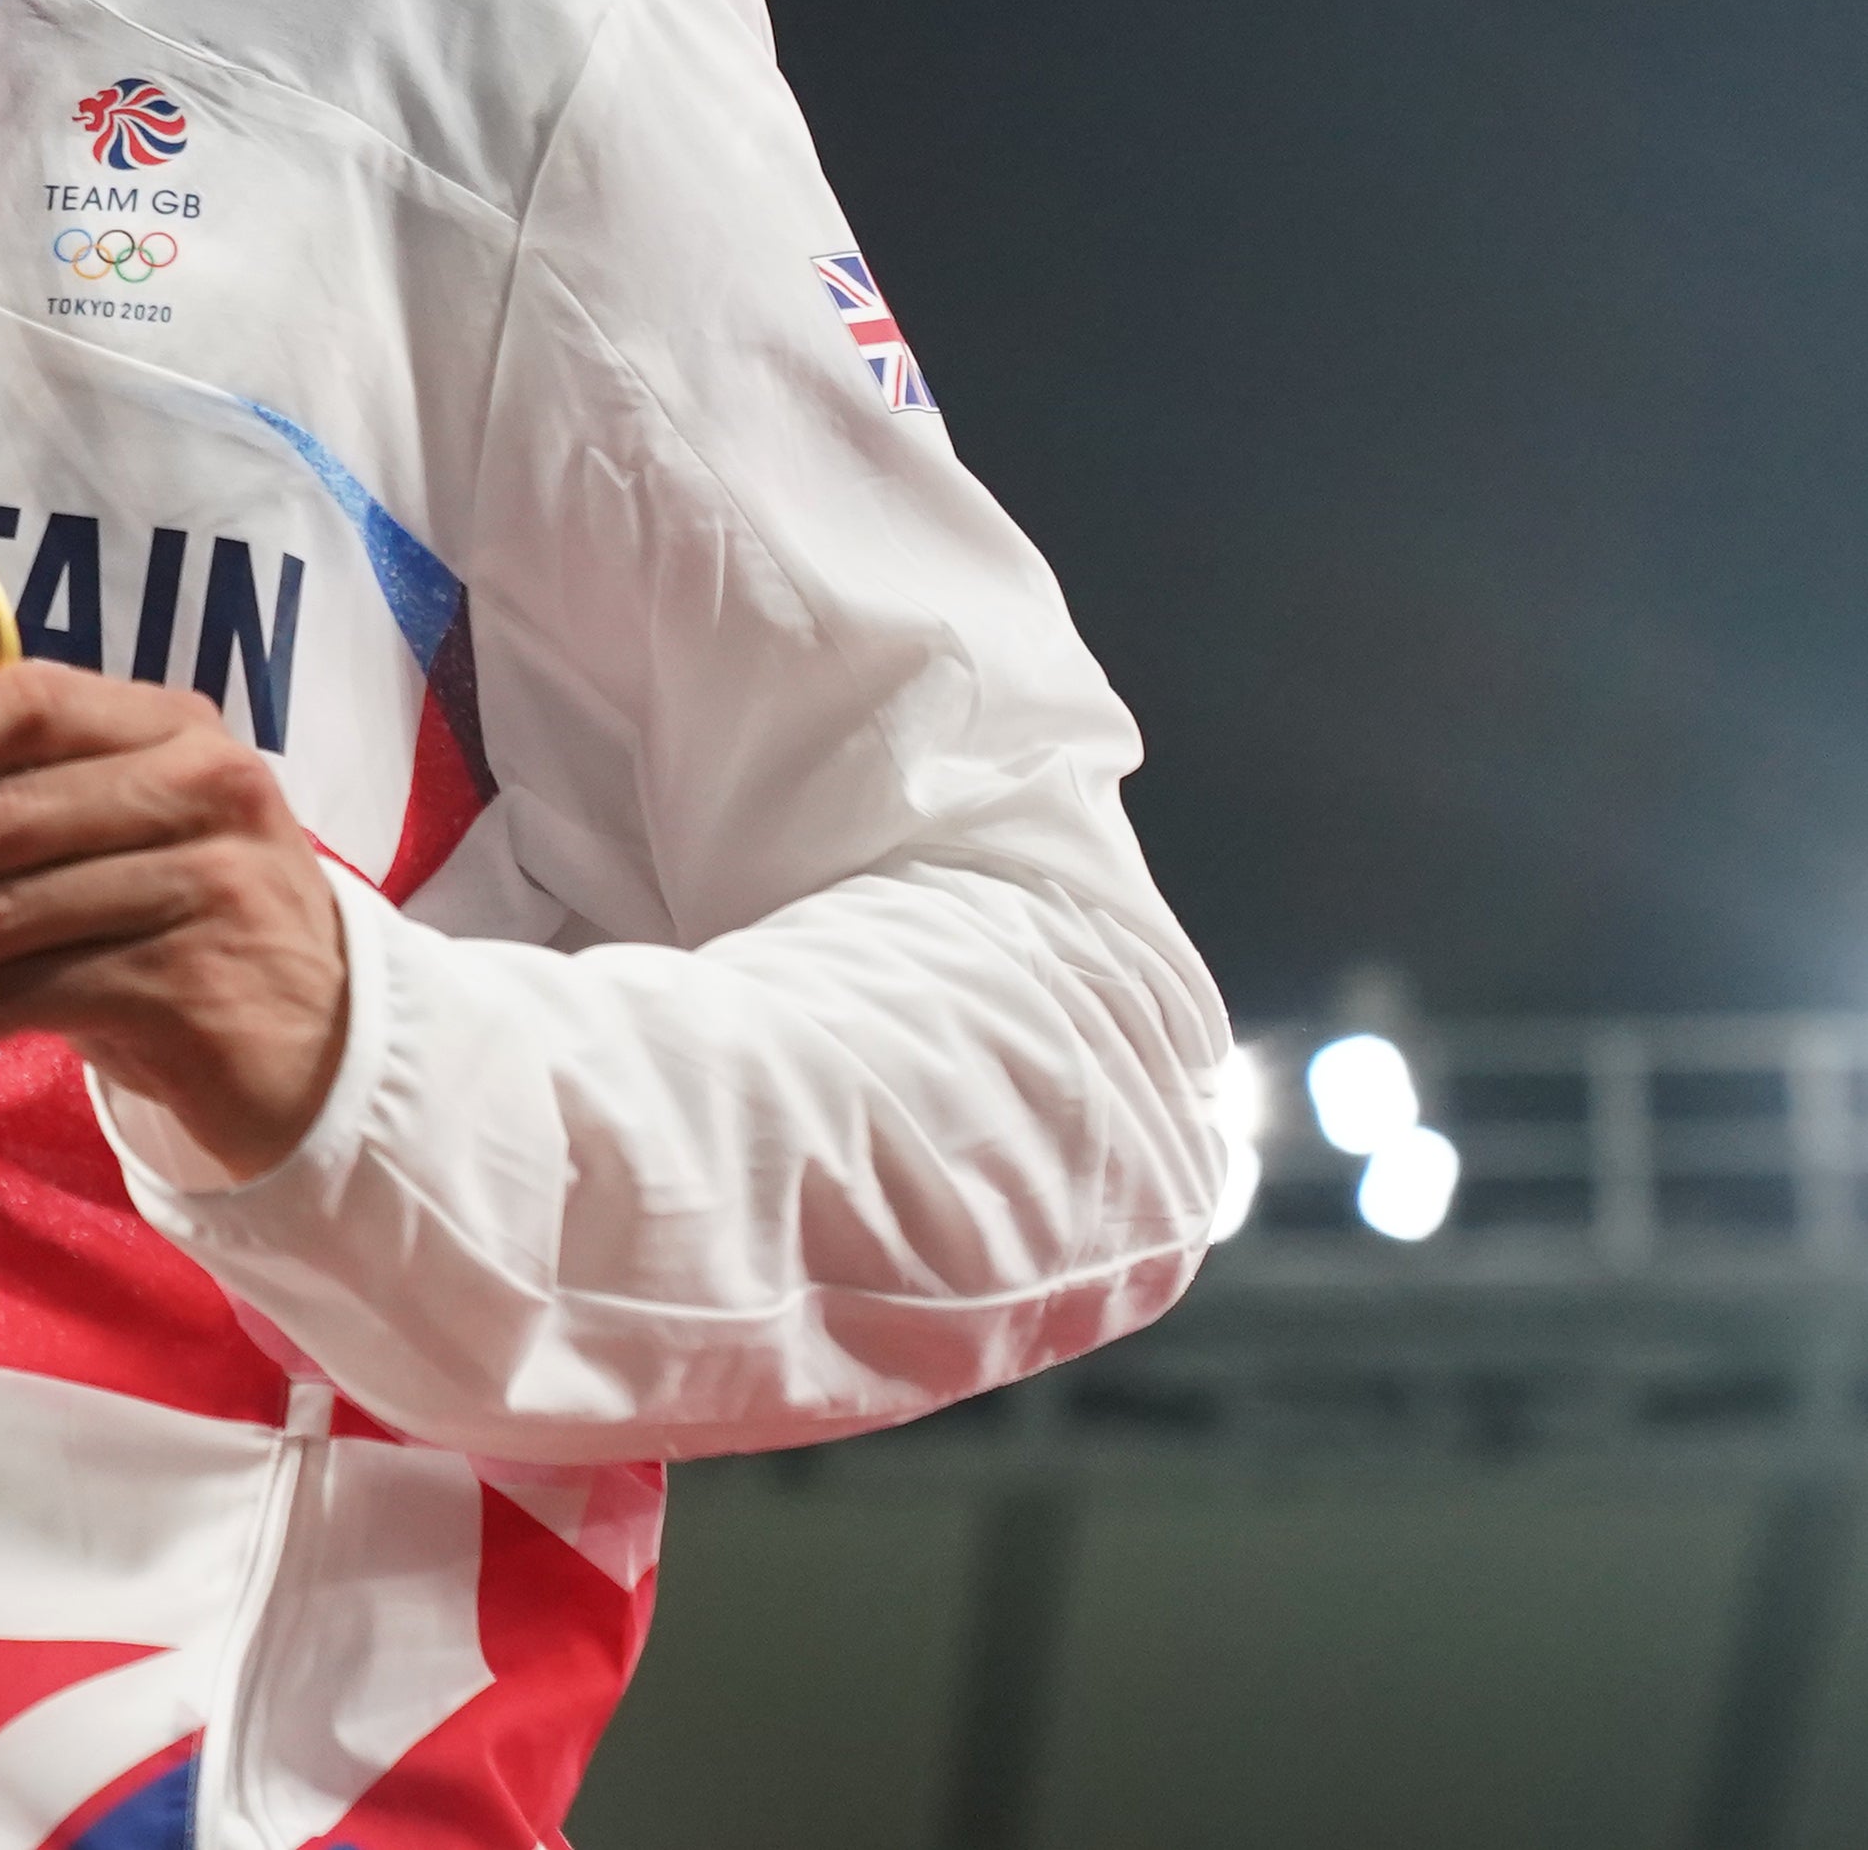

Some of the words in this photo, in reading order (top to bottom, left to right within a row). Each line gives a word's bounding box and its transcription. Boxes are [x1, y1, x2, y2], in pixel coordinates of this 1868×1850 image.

[44, 185, 138, 212] TEAM
[152, 190, 200, 219] GB
[47, 298, 115, 318] TOKYO
[121, 302, 172, 323] 2020
